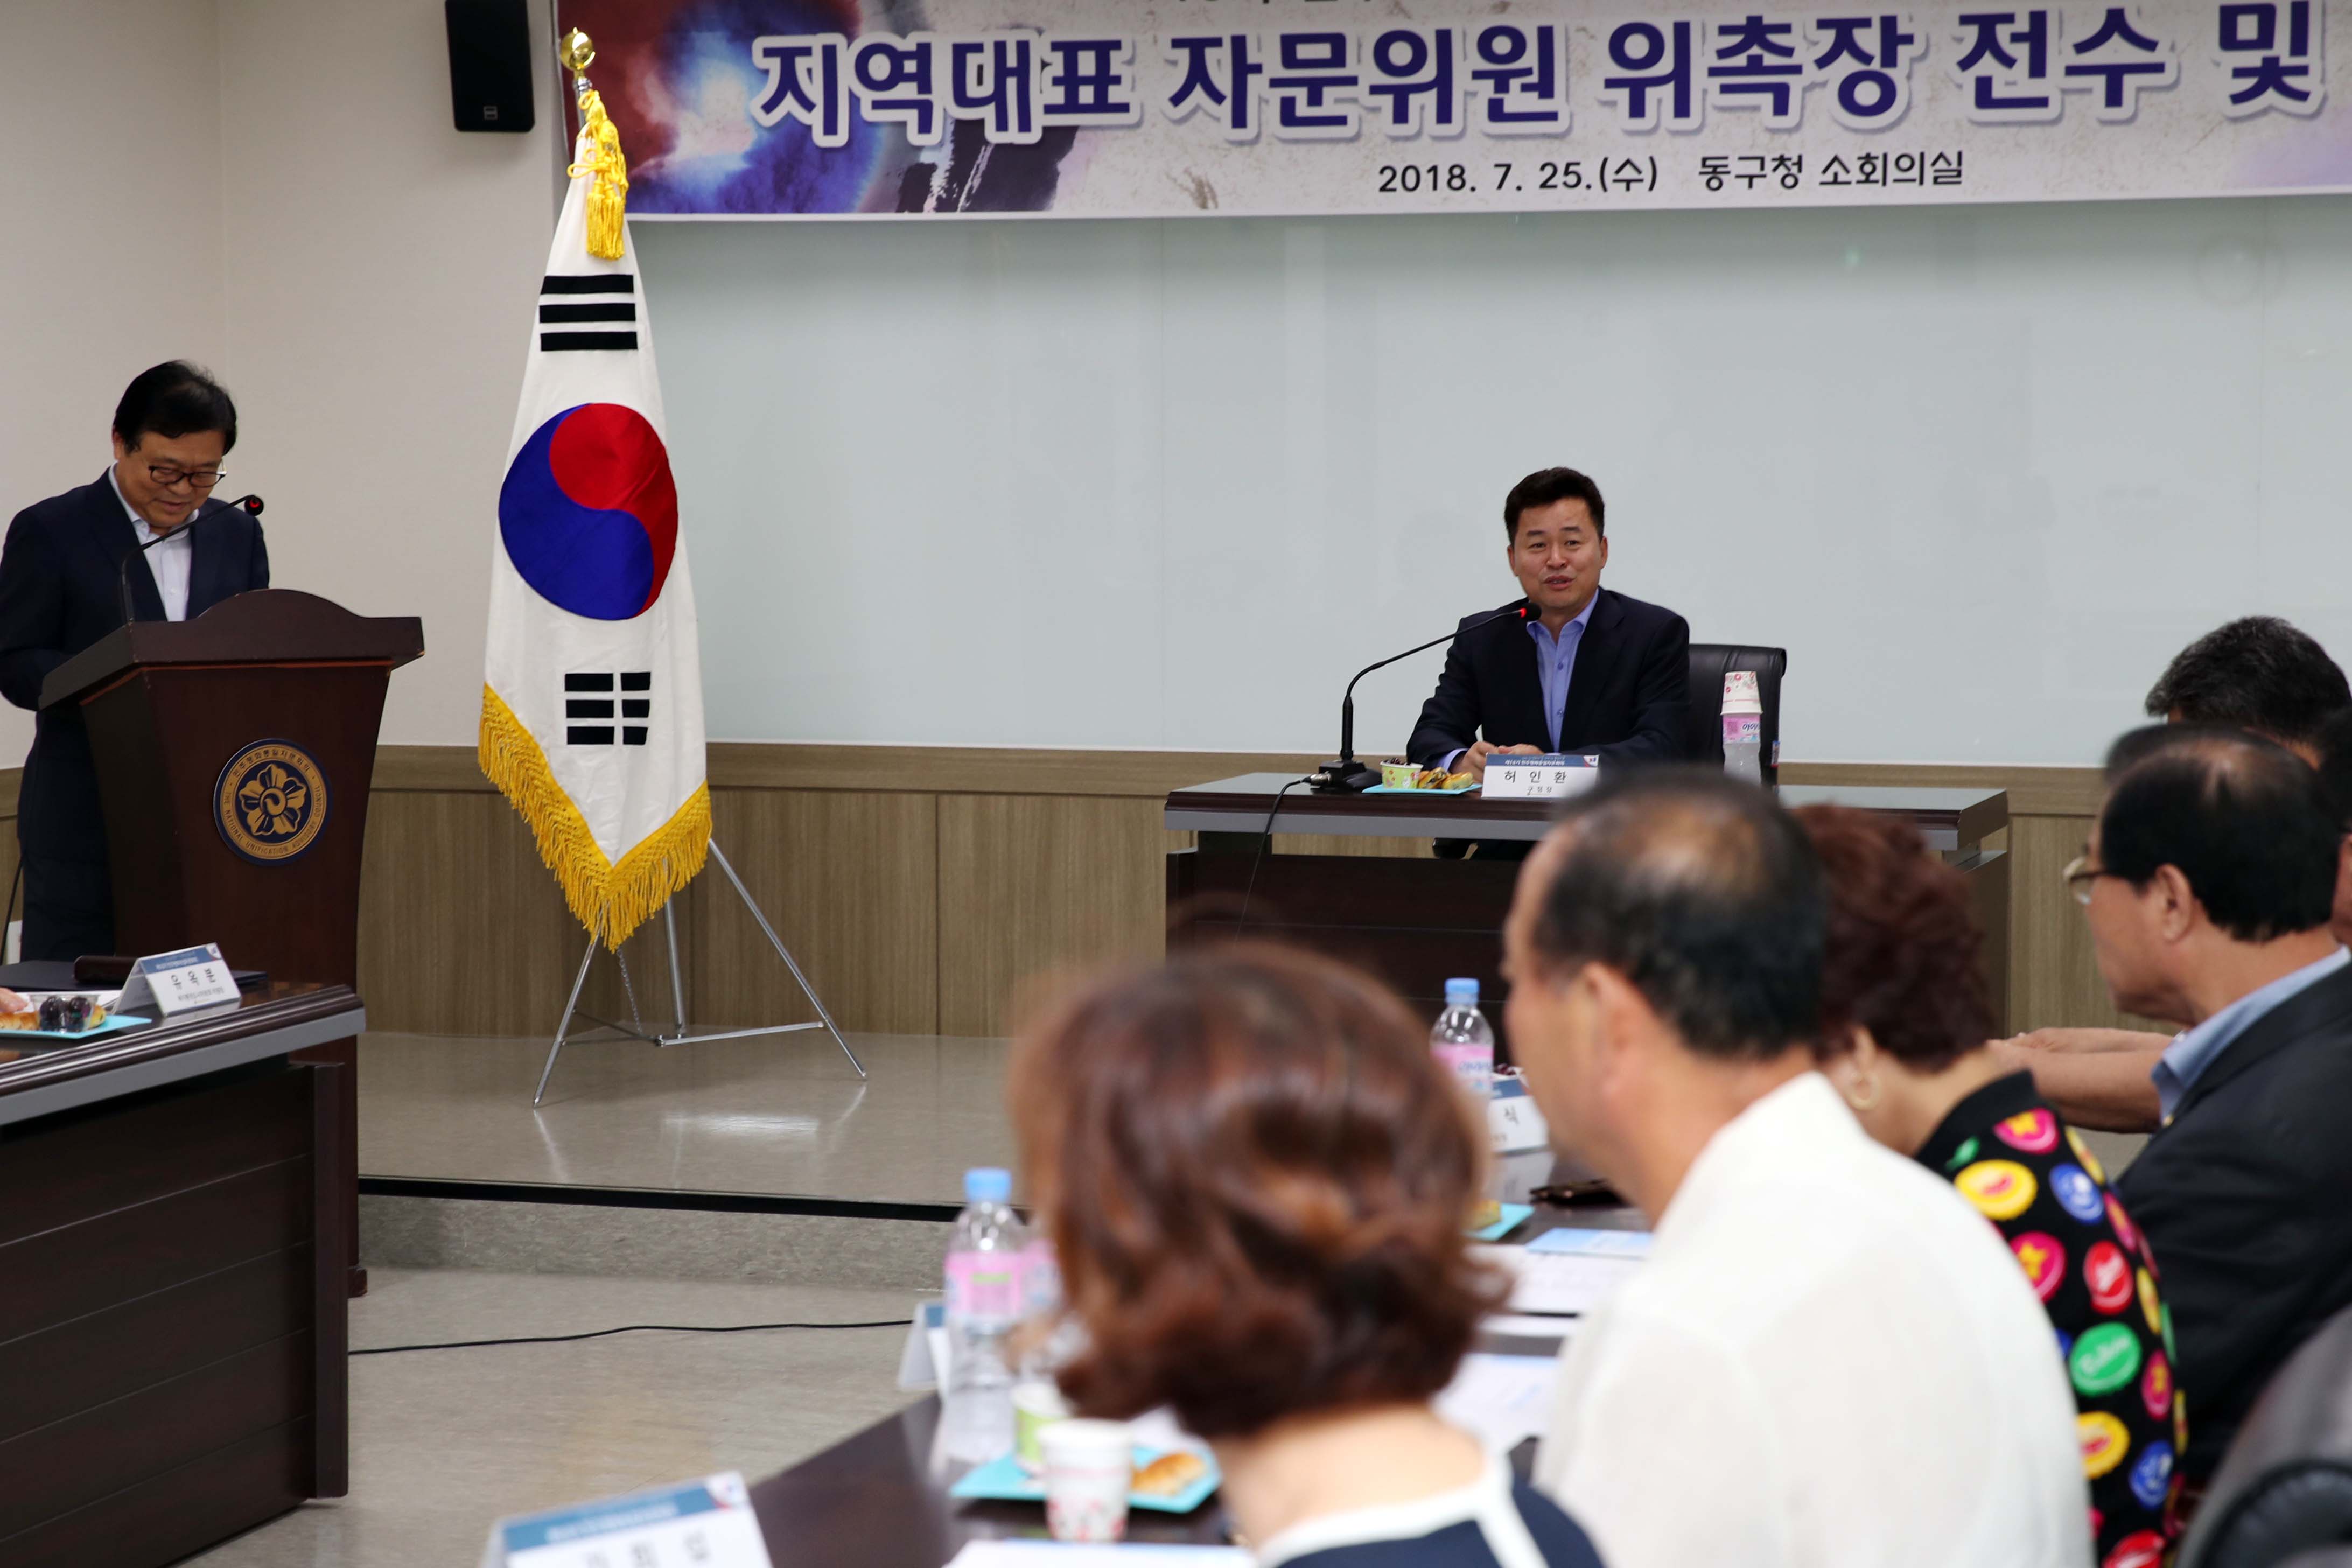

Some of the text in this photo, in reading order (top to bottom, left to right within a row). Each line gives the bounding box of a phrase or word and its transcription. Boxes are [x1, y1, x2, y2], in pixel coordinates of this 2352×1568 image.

[761, 1, 2311, 137] 지역대표 자문위원 위촉장 전수 및
[1378, 150, 1963, 192] 2018. 7. 25.(수) 동구청 소회의실
[225, 810, 243, 841] NATIONAL
